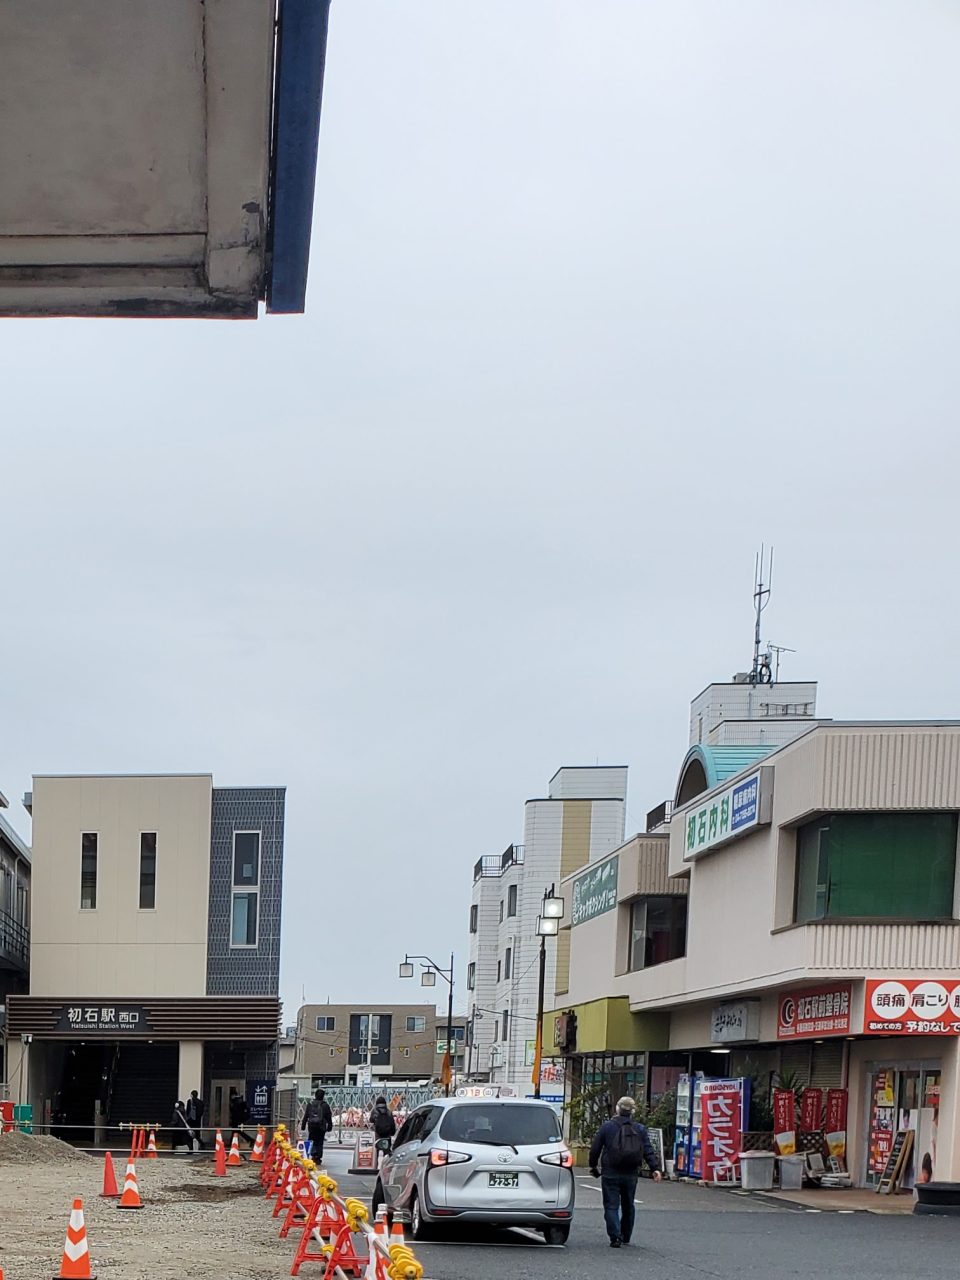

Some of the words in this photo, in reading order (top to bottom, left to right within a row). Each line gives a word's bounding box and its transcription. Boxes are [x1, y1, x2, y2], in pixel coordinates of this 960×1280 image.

[687, 795, 730, 852] 初石内科
[876, 993, 906, 1008] 頭痛
[911, 993, 949, 1008] 肩こり
[67, 1007, 116, 1022] 初石駅
[118, 1011, 139, 1023] 西口
